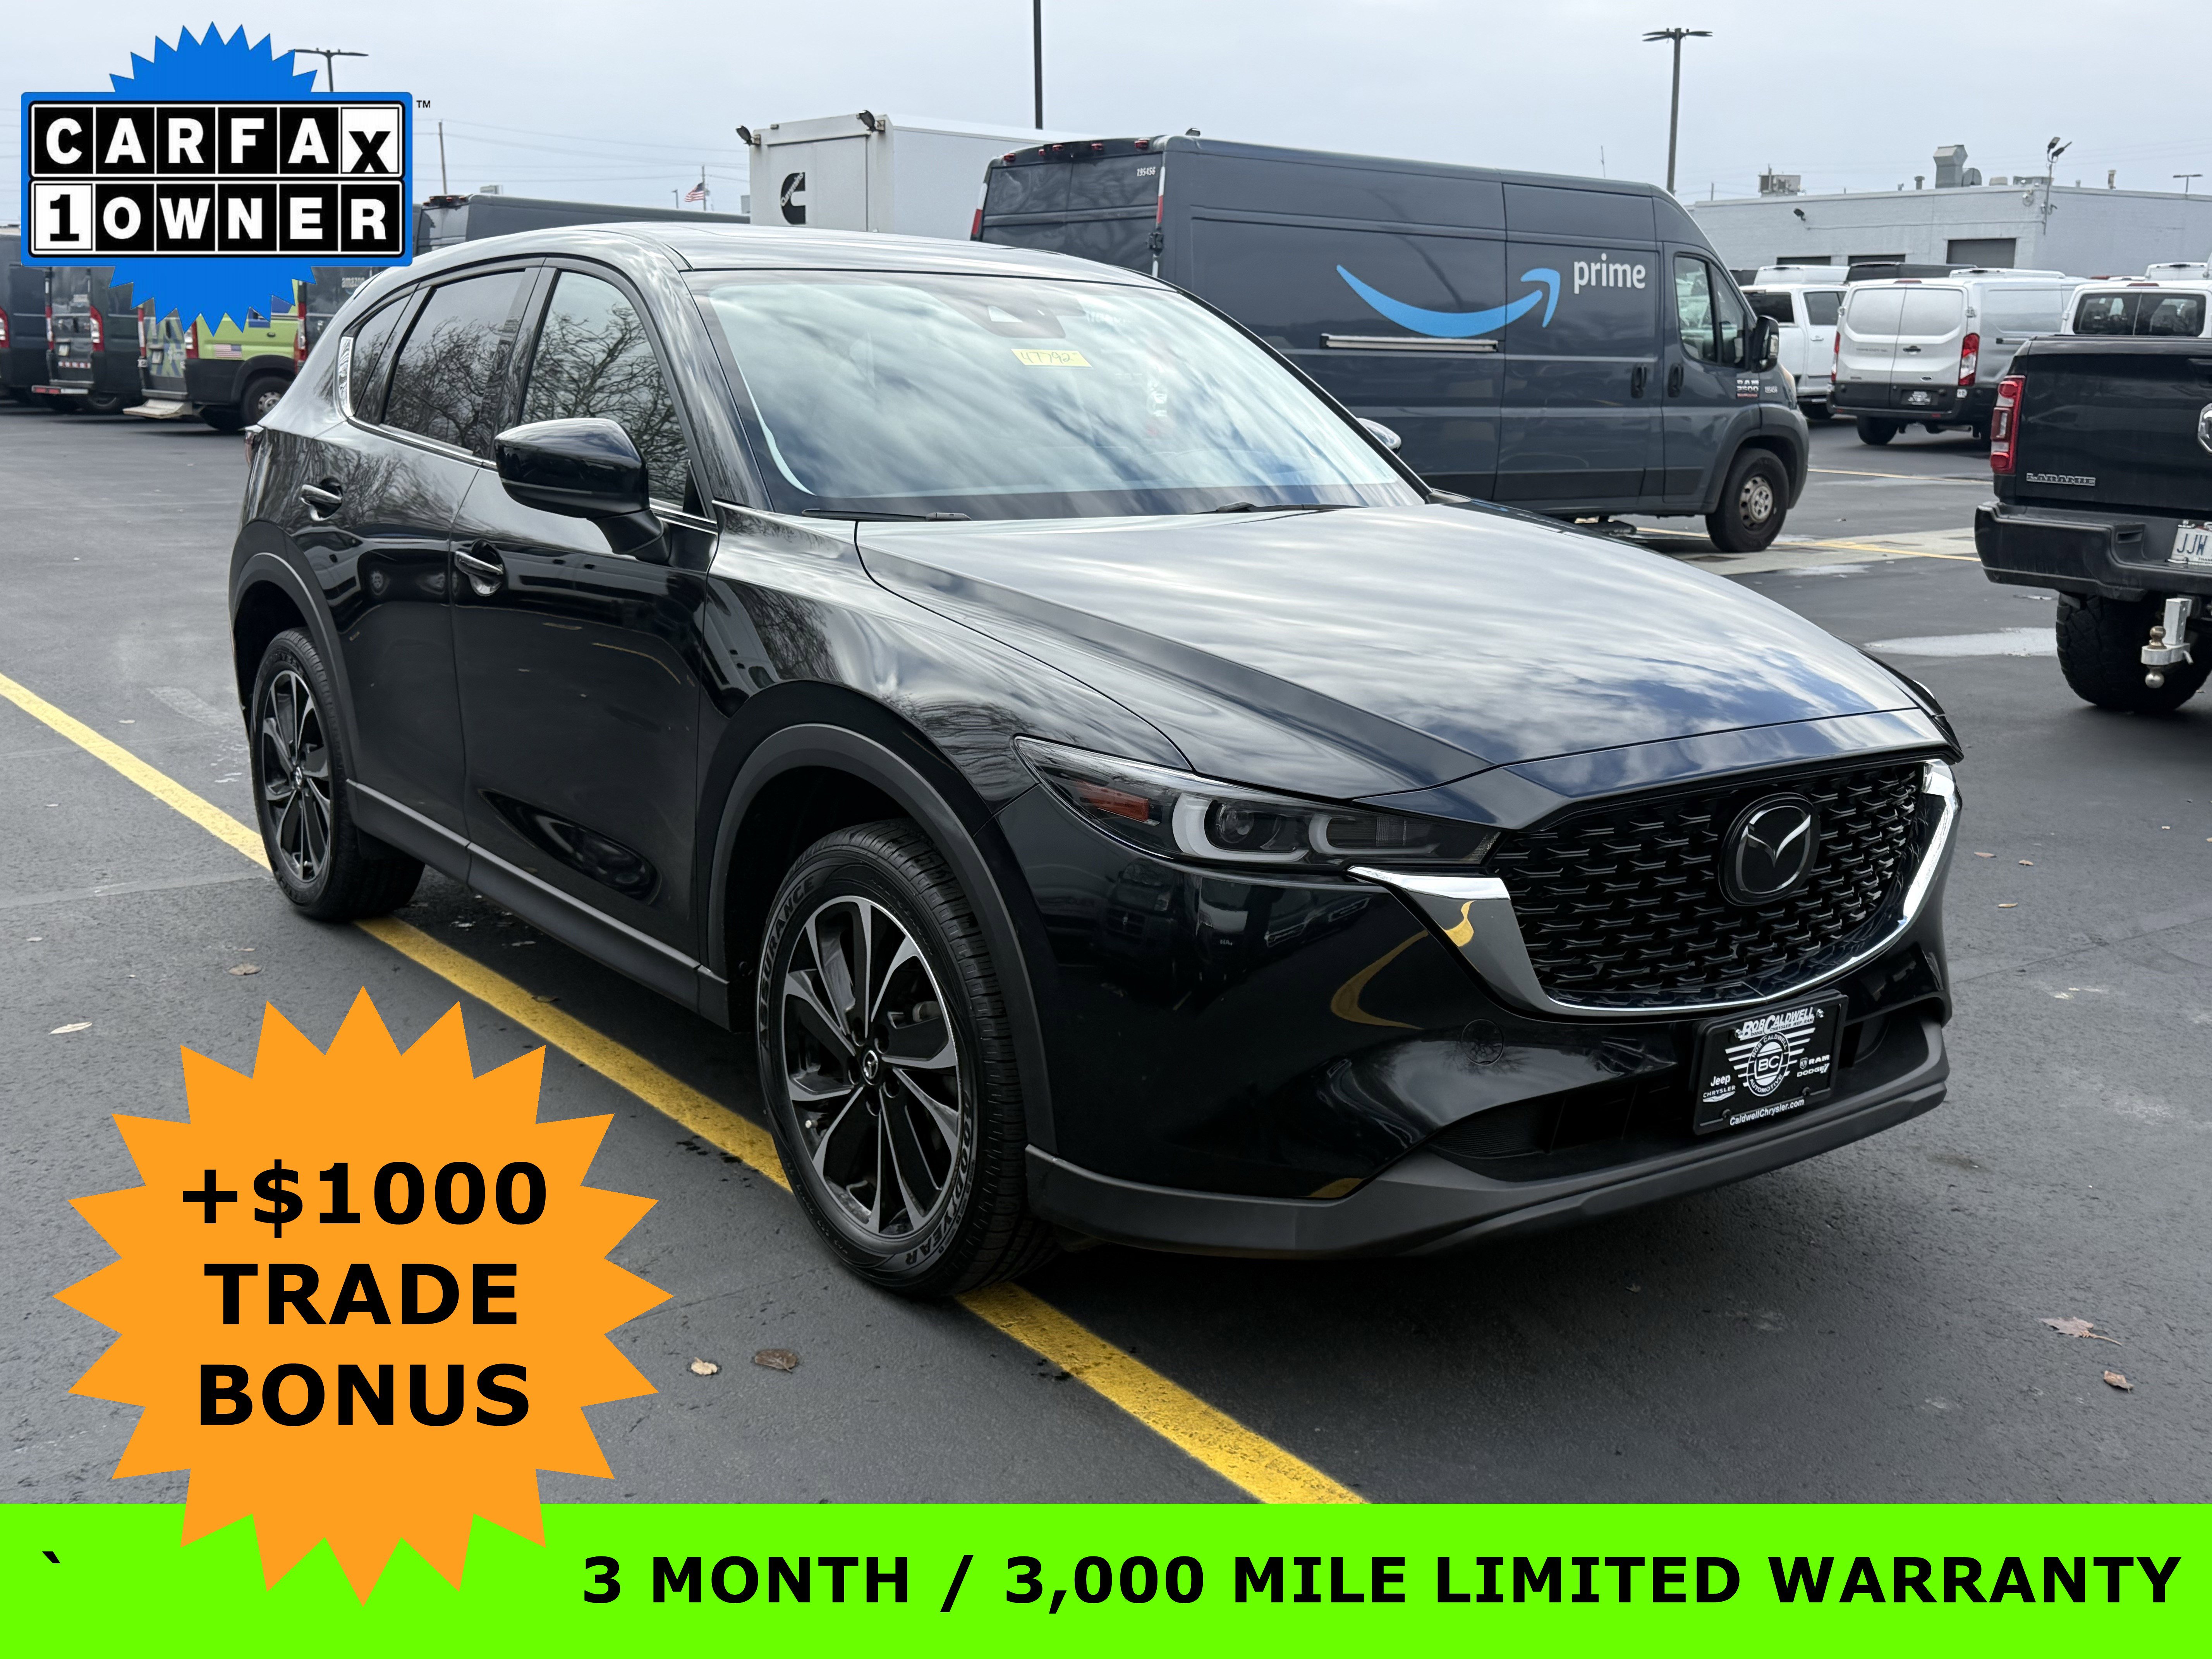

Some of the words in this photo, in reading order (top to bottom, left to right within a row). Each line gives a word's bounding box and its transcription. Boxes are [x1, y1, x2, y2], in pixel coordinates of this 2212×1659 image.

[1574, 253, 1645, 294] prime
[2027, 473, 2096, 486] LARAMIE
[1752, 1043, 1762, 1058] BOB
[1764, 1034, 1788, 1050] CALDWELL
[1758, 1055, 1780, 1072] BC
[1808, 1054, 1830, 1065] RAM
[1797, 1065, 1825, 1077] DODGE
[1711, 1075, 1731, 1086] Jeep
[1749, 1073, 1783, 1093] AUTOMOTIVE
[1703, 1085, 1736, 1097] CHRYSLER
[1729, 1099, 1805, 1126] CaldwellChrysler.com
